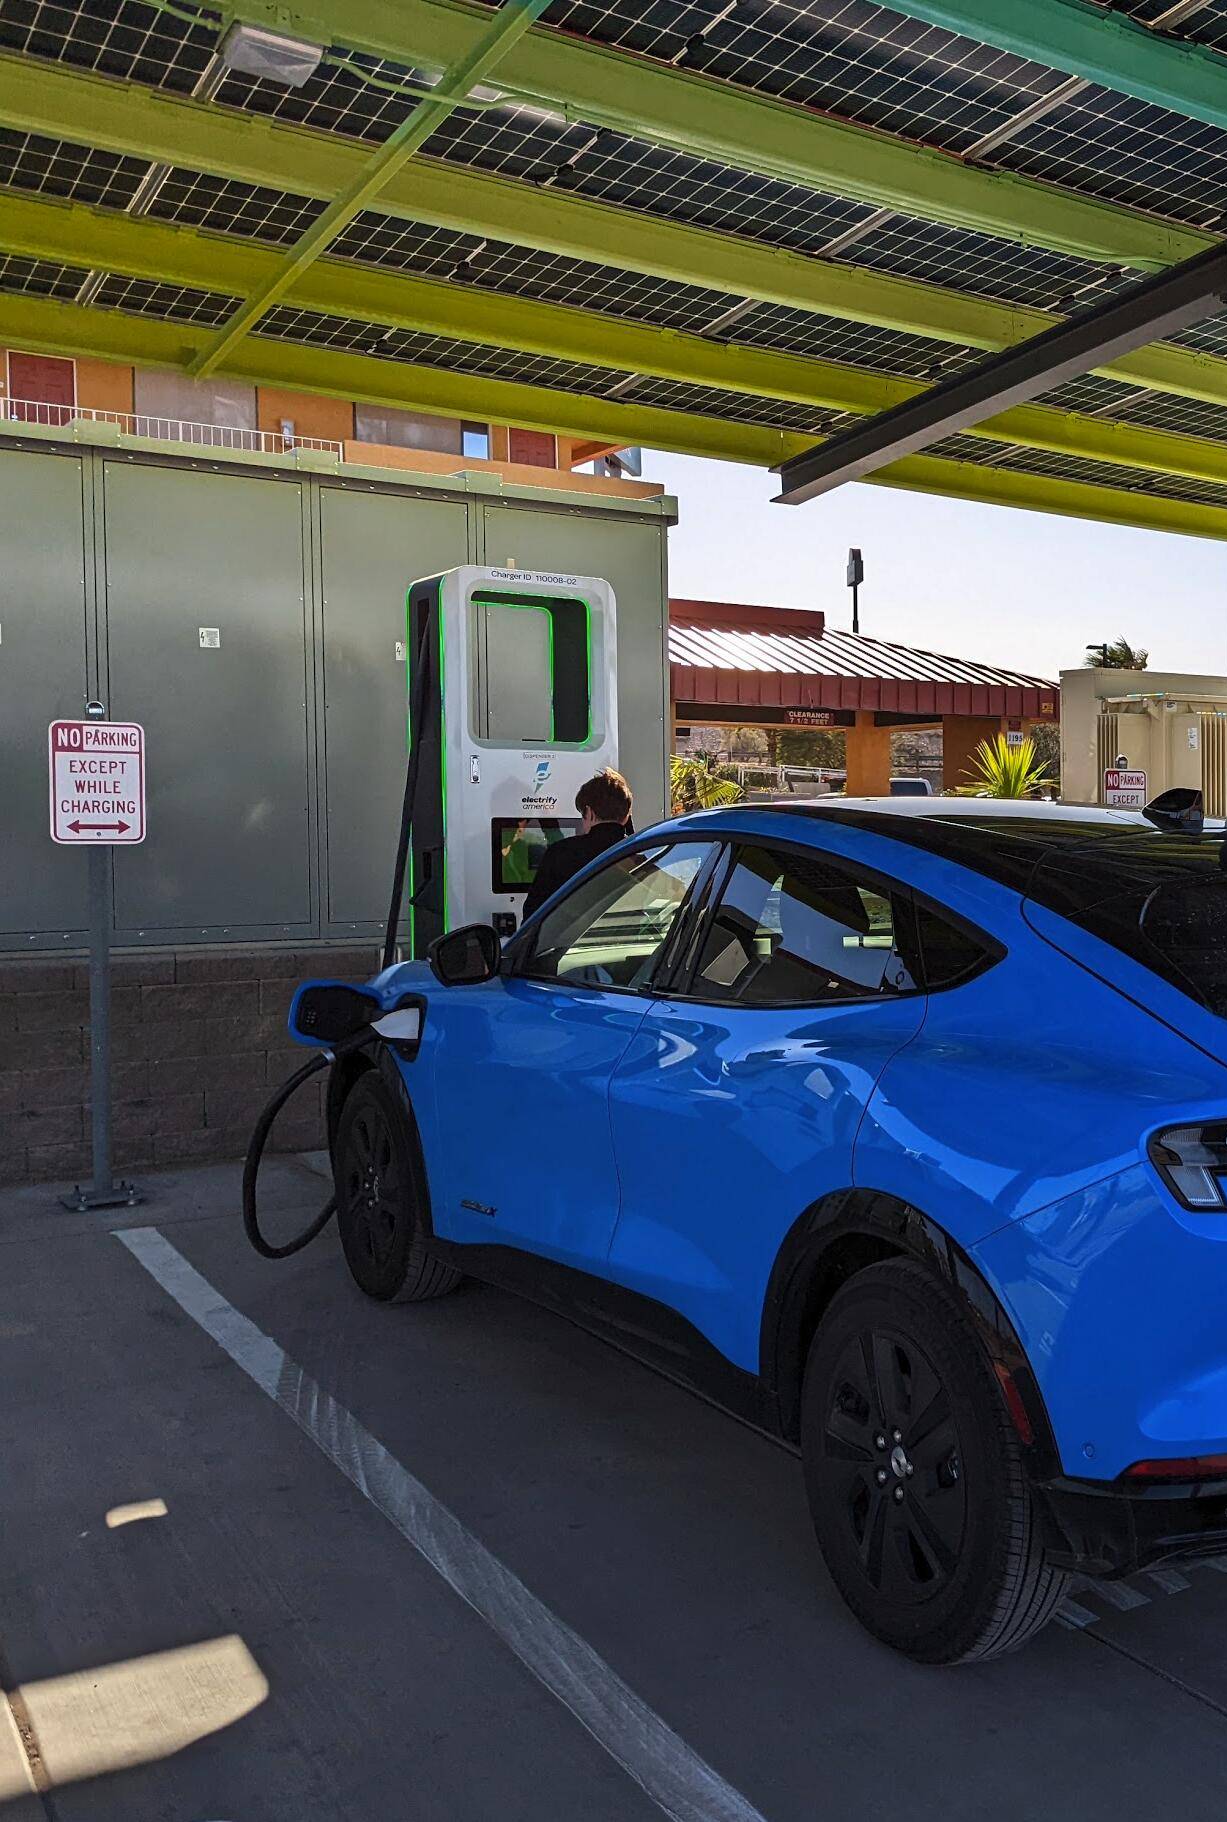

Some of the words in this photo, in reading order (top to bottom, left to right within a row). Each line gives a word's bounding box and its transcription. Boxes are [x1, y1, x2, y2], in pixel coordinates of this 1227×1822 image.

[491, 570, 521, 580] Charger
[788, 711, 830, 719] CLEARANCE
[57, 727, 81, 748] NO
[85, 731, 137, 746] PARKING
[69, 760, 127, 774] EXCEPT
[74, 780, 122, 794] WHILE
[1107, 773, 1119, 787] NO
[1120, 774, 1144, 786] PARKING
[521, 796, 558, 804] electrify
[1112, 795, 1140, 804] EXCEPT
[60, 800, 136, 814] CHARGING
